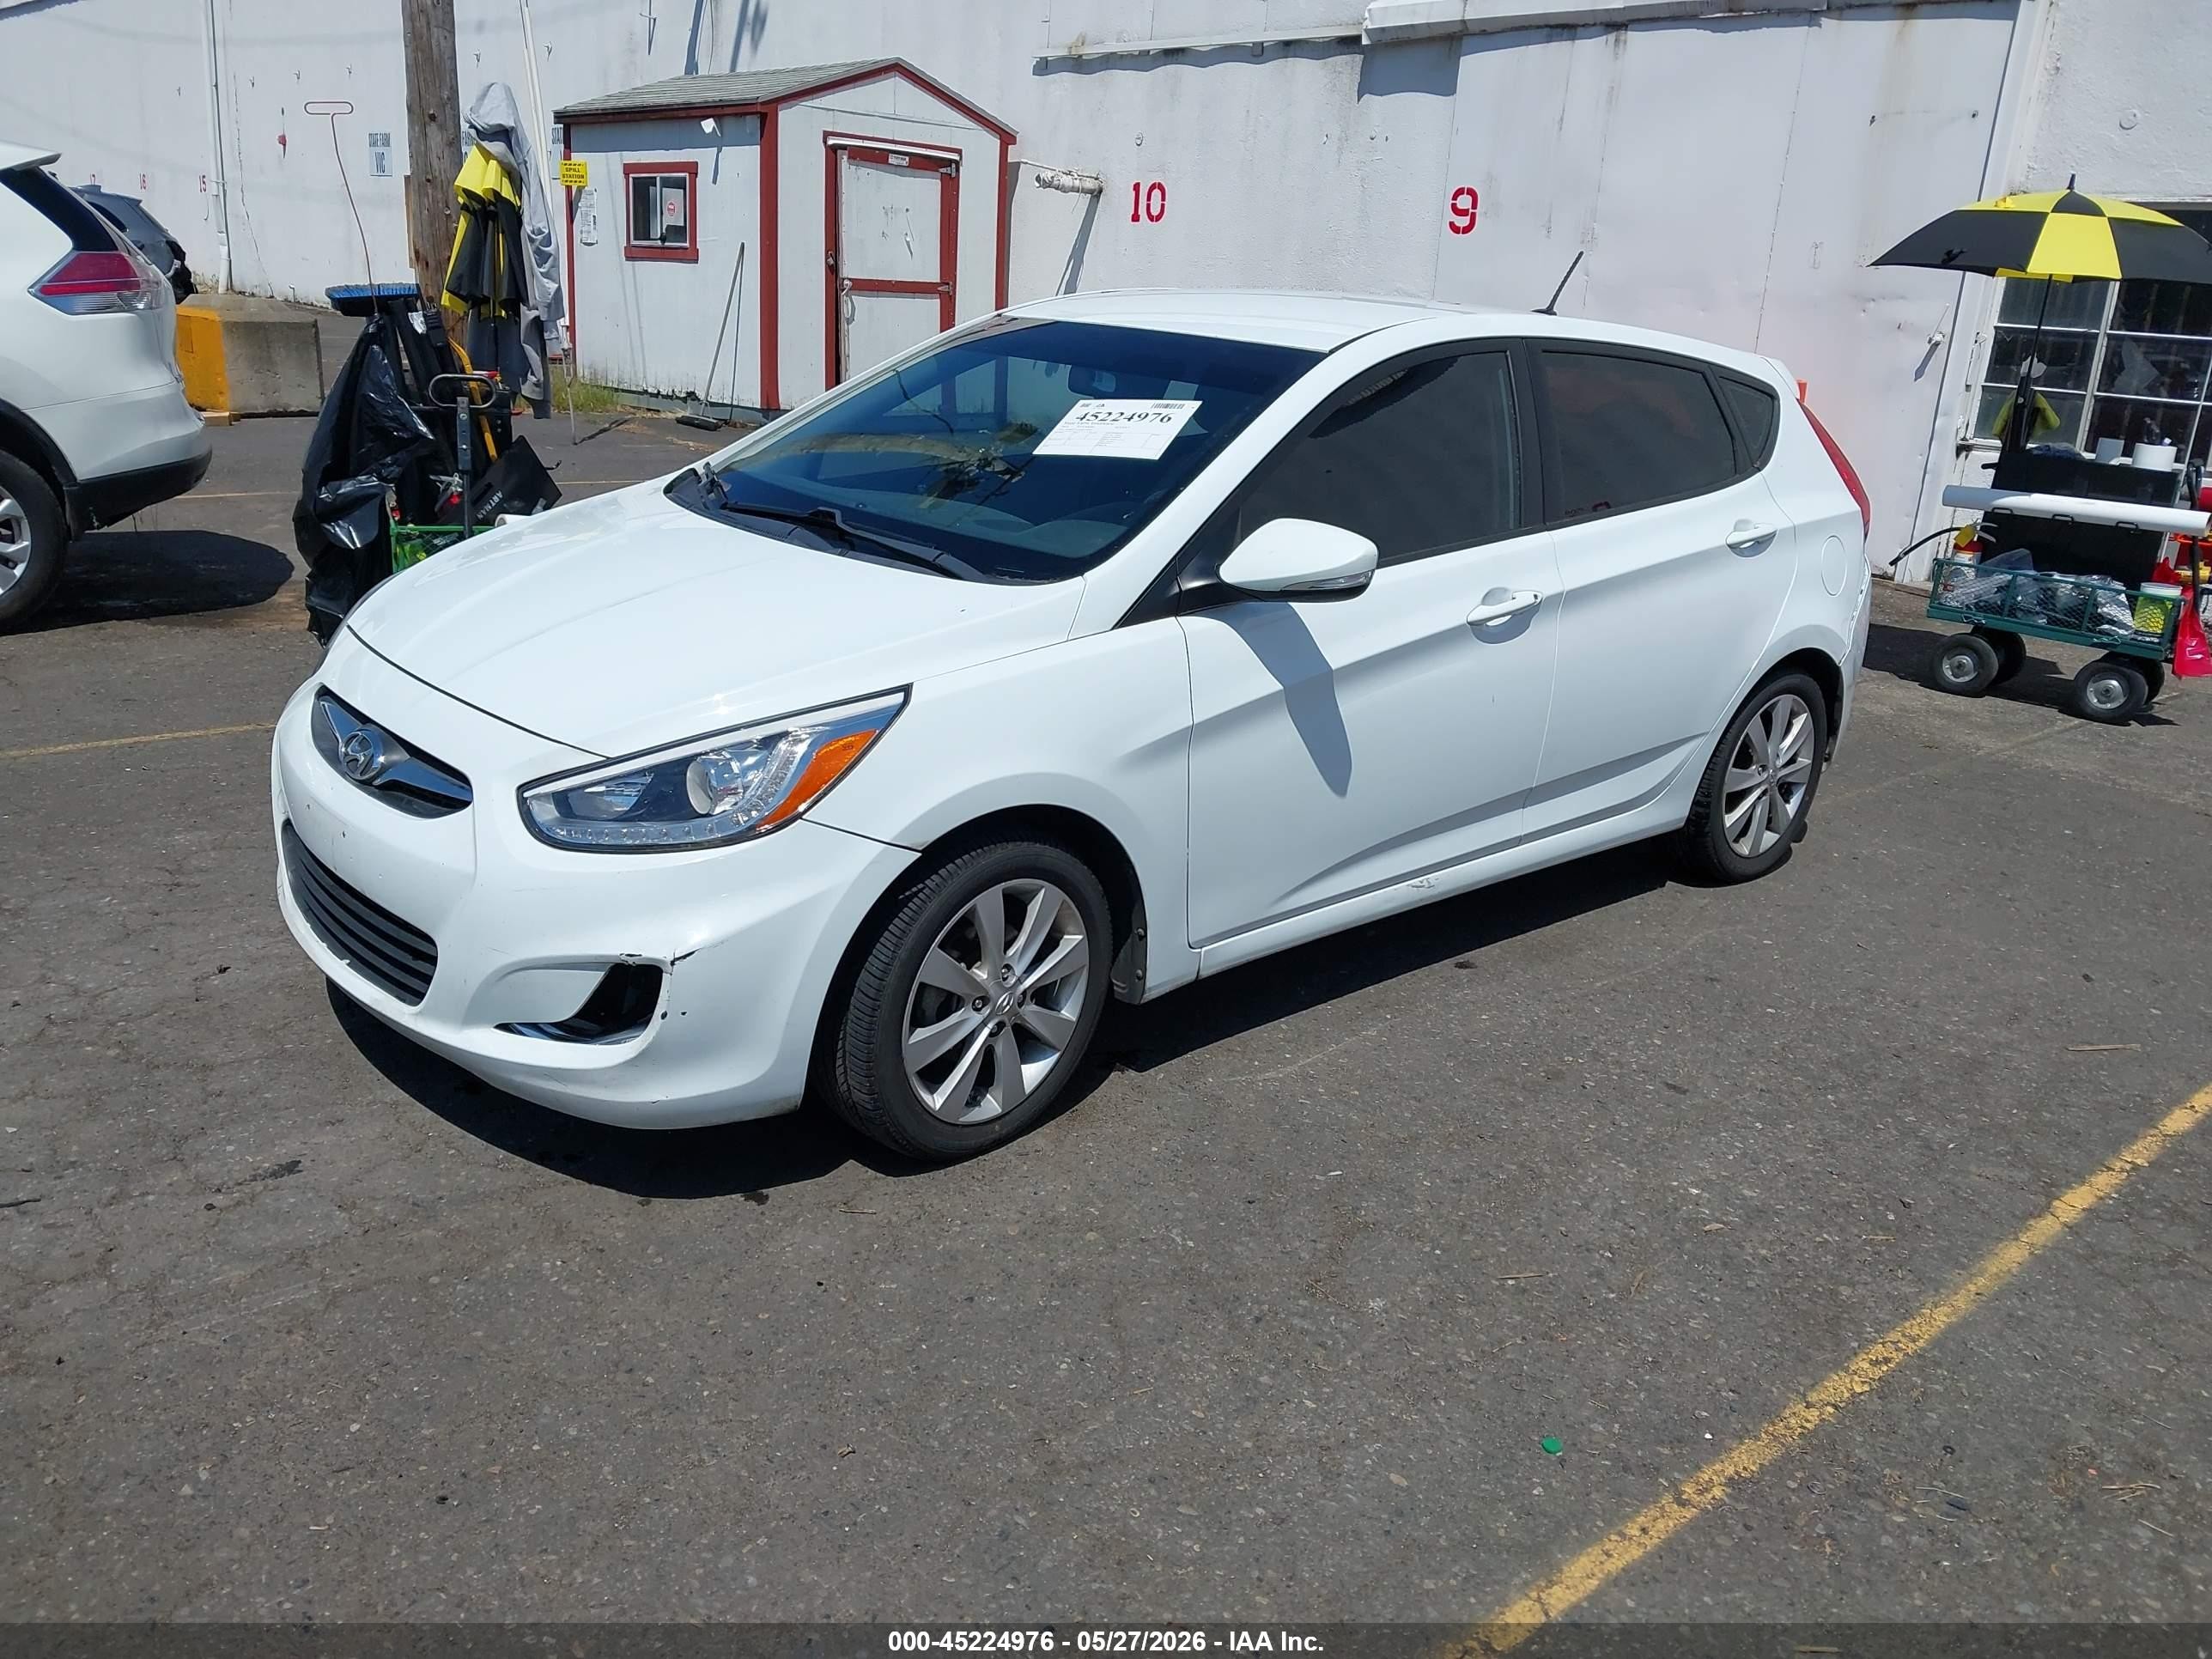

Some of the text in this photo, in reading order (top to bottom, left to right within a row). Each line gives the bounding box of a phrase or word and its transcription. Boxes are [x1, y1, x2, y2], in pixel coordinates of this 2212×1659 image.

[551, 126, 563, 145] STAT
[374, 151, 386, 173] VIC
[139, 173, 147, 190] 16
[198, 174, 207, 193] 15
[1130, 181, 1168, 223] 10
[1448, 186, 1480, 235] 9
[1075, 411, 1176, 423] 45224976
